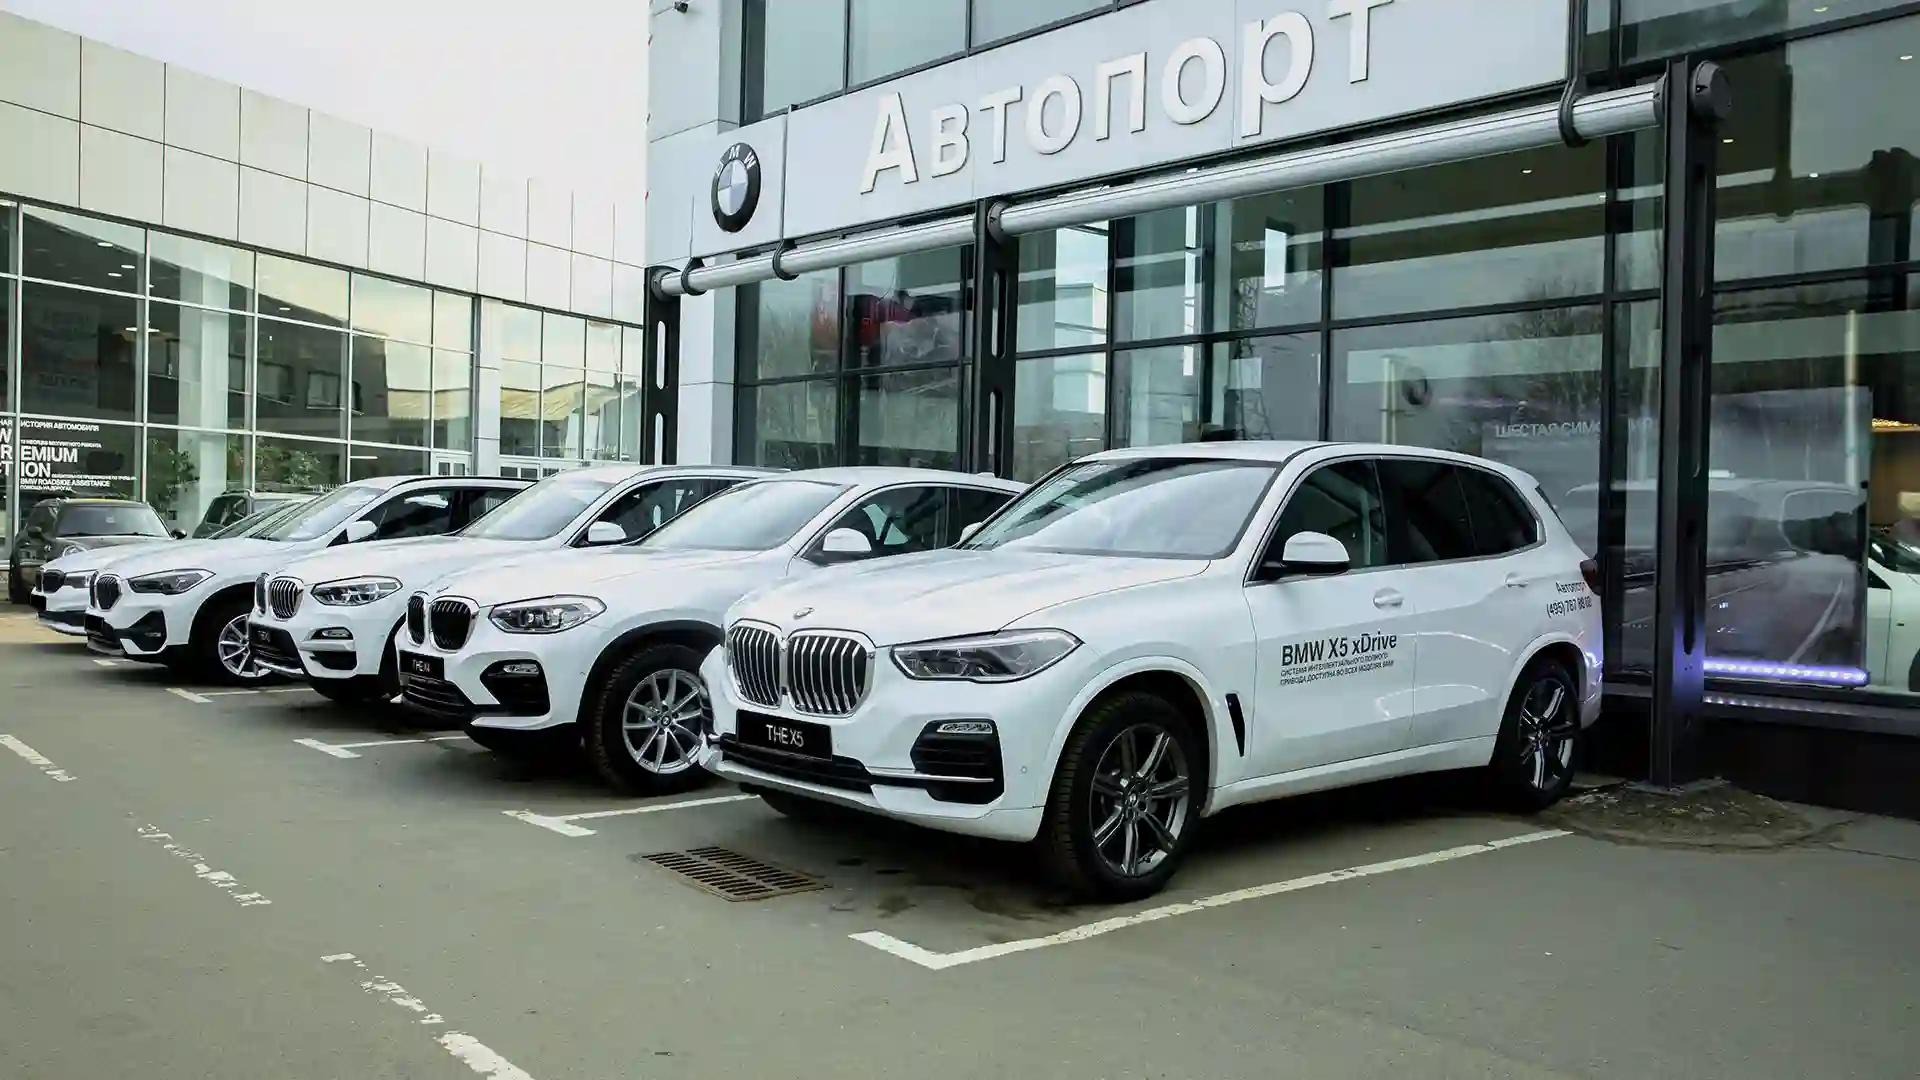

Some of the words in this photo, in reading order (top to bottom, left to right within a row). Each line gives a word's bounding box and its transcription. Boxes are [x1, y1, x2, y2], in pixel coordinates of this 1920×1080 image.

[860, 0, 1394, 195] Автопорт
[714, 144, 757, 177] BMW
[20, 420, 53, 429] ИСТОРИЯ
[53, 422, 99, 431] АВТОМОБИЛЯ
[1495, 423, 1559, 438] ШЕСТАЯ
[1546, 601, 1566, 619] (495)
[1282, 640, 1324, 666] BMW
[1328, 637, 1348, 659] X5
[1352, 630, 1397, 655] xDrive
[1280, 667, 1307, 676] СИСТЕМА
[1280, 675, 1306, 686] ПРИВОДА
[1307, 671, 1336, 684] ДОСТУПНА
[765, 724, 789, 745] THE
[789, 727, 805, 748] X5
